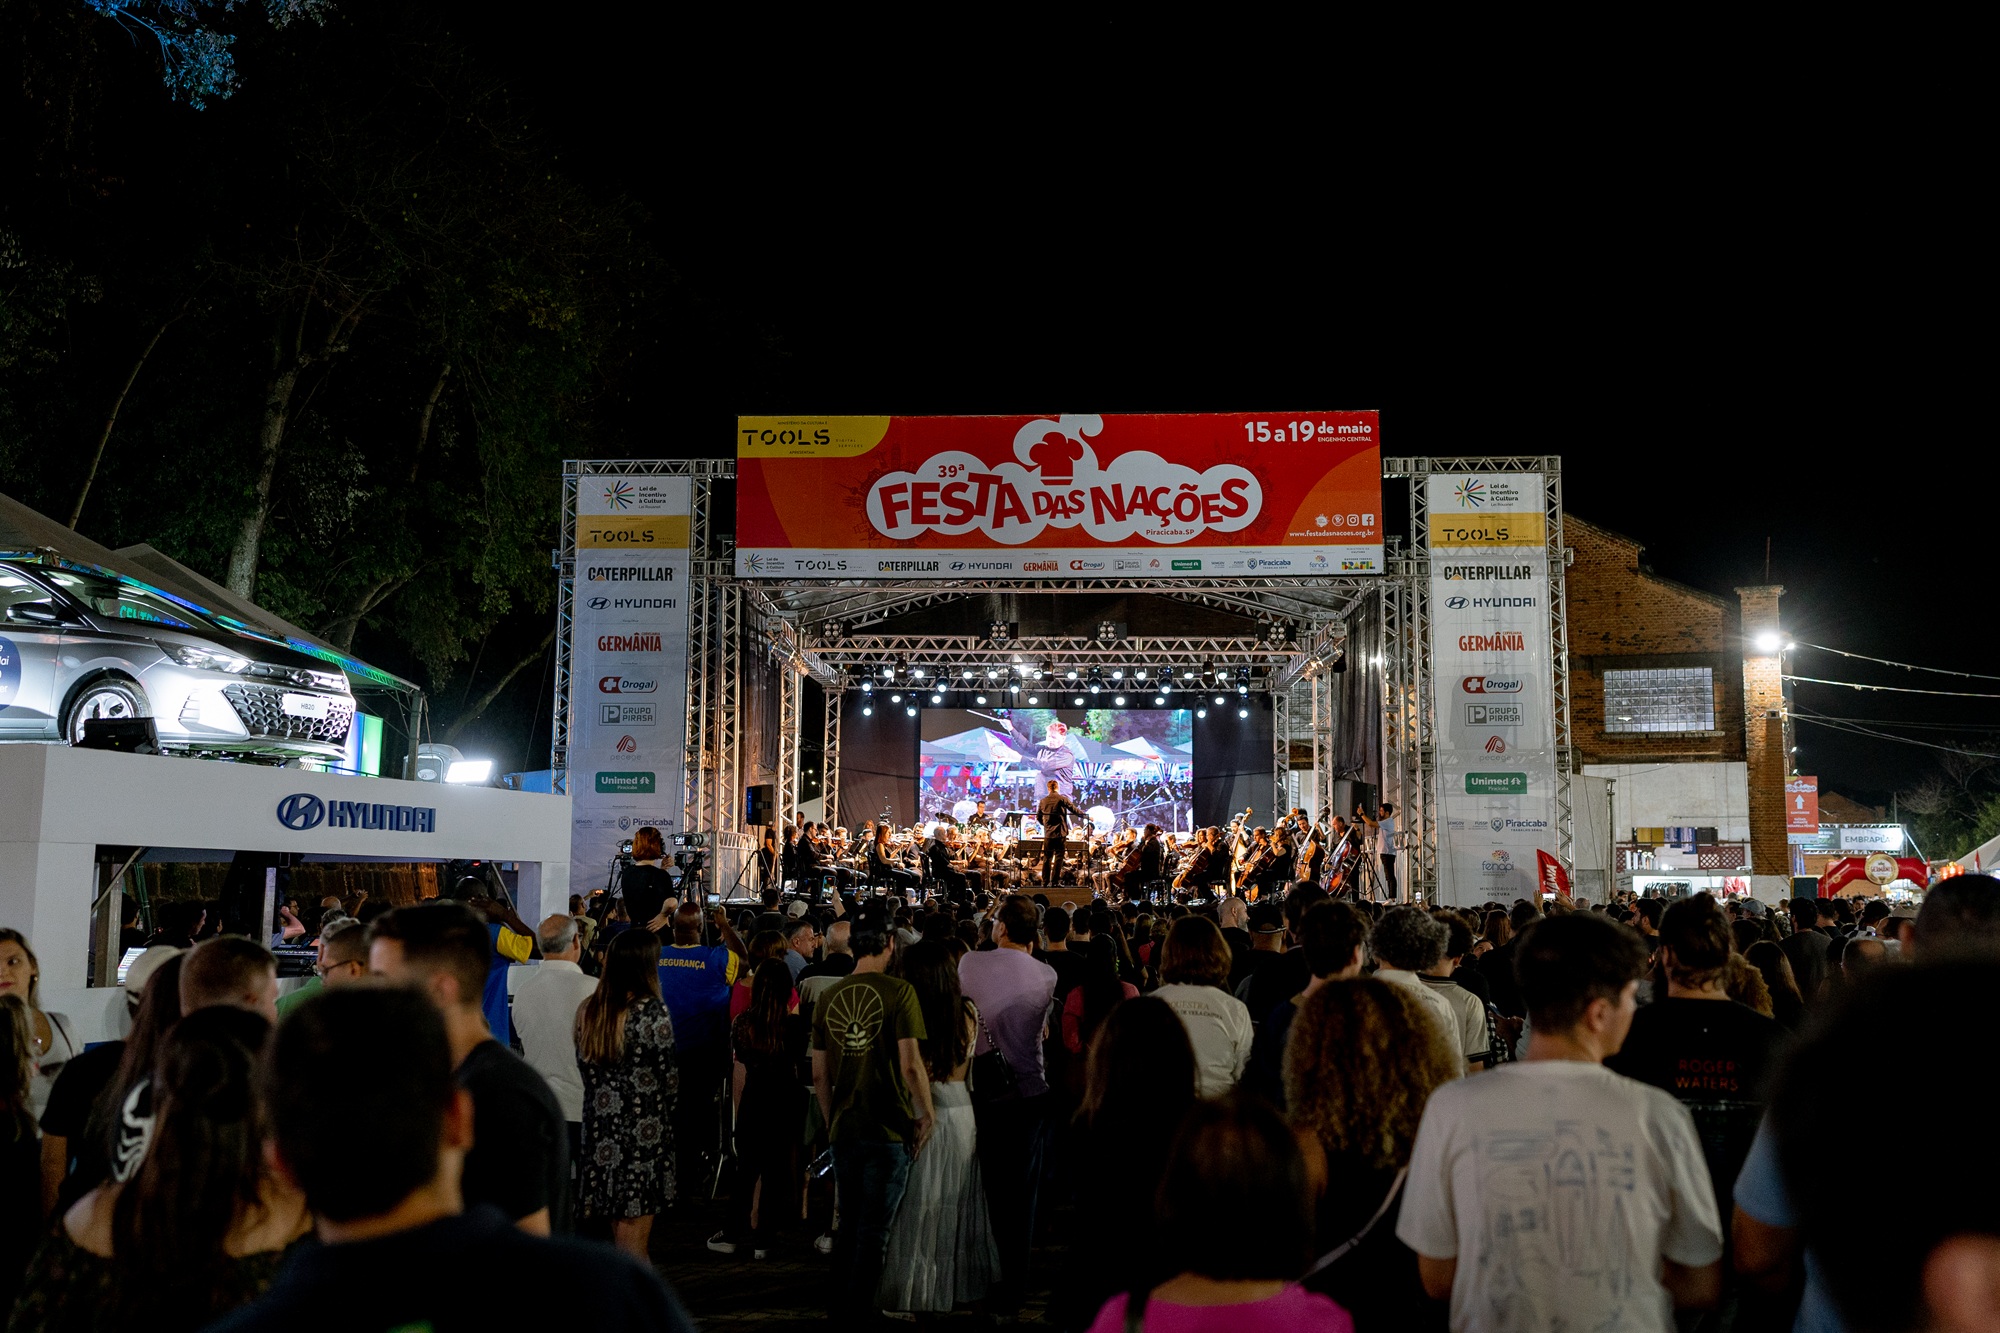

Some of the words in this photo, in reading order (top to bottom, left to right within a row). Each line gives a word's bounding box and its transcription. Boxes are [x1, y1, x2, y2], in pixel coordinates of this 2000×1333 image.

[1245, 421, 1270, 442] 15
[1274, 428, 1286, 442] a
[1288, 420, 1314, 442] 19
[1317, 421, 1335, 435] de
[1338, 420, 1372, 434] maio
[742, 430, 830, 445] TOOLS
[938, 464, 964, 478] 39ª
[878, 472, 1032, 530] FESTA
[1032, 489, 1085, 519] DAS
[1090, 478, 1249, 528] NAÇÕES
[590, 530, 654, 542] TOOLS
[1289, 529, 1374, 538] www.festadasnacoes.org.br
[1442, 528, 1509, 541] TOOLS
[795, 560, 847, 570] TOOLS
[878, 561, 939, 571] CATERPILLAR
[1024, 561, 1058, 571] GERMÂNIA
[1342, 561, 1375, 570] BRASIL
[588, 567, 673, 581] CATERPILLAR
[1444, 566, 1531, 580] CATERPILLAR
[615, 599, 676, 608] HYUNDAI
[1474, 598, 1536, 607] HYUNDAI
[598, 632, 662, 651] GERMÂNIA
[1459, 631, 1524, 651] GERMÂNIA
[622, 680, 654, 689] Drogal
[1486, 680, 1519, 690] Drogal
[1472, 777, 1508, 785] Unimed
[328, 800, 436, 833] HYUNDAI
[633, 818, 673, 826] Piracicaba
[1506, 819, 1547, 828] Piracicaba
[1482, 861, 1515, 873] fenapi
[658, 958, 705, 970] SEGURANÇA
[1679, 1060, 1735, 1074] ROGER
[1676, 1076, 1738, 1092] WATERS
